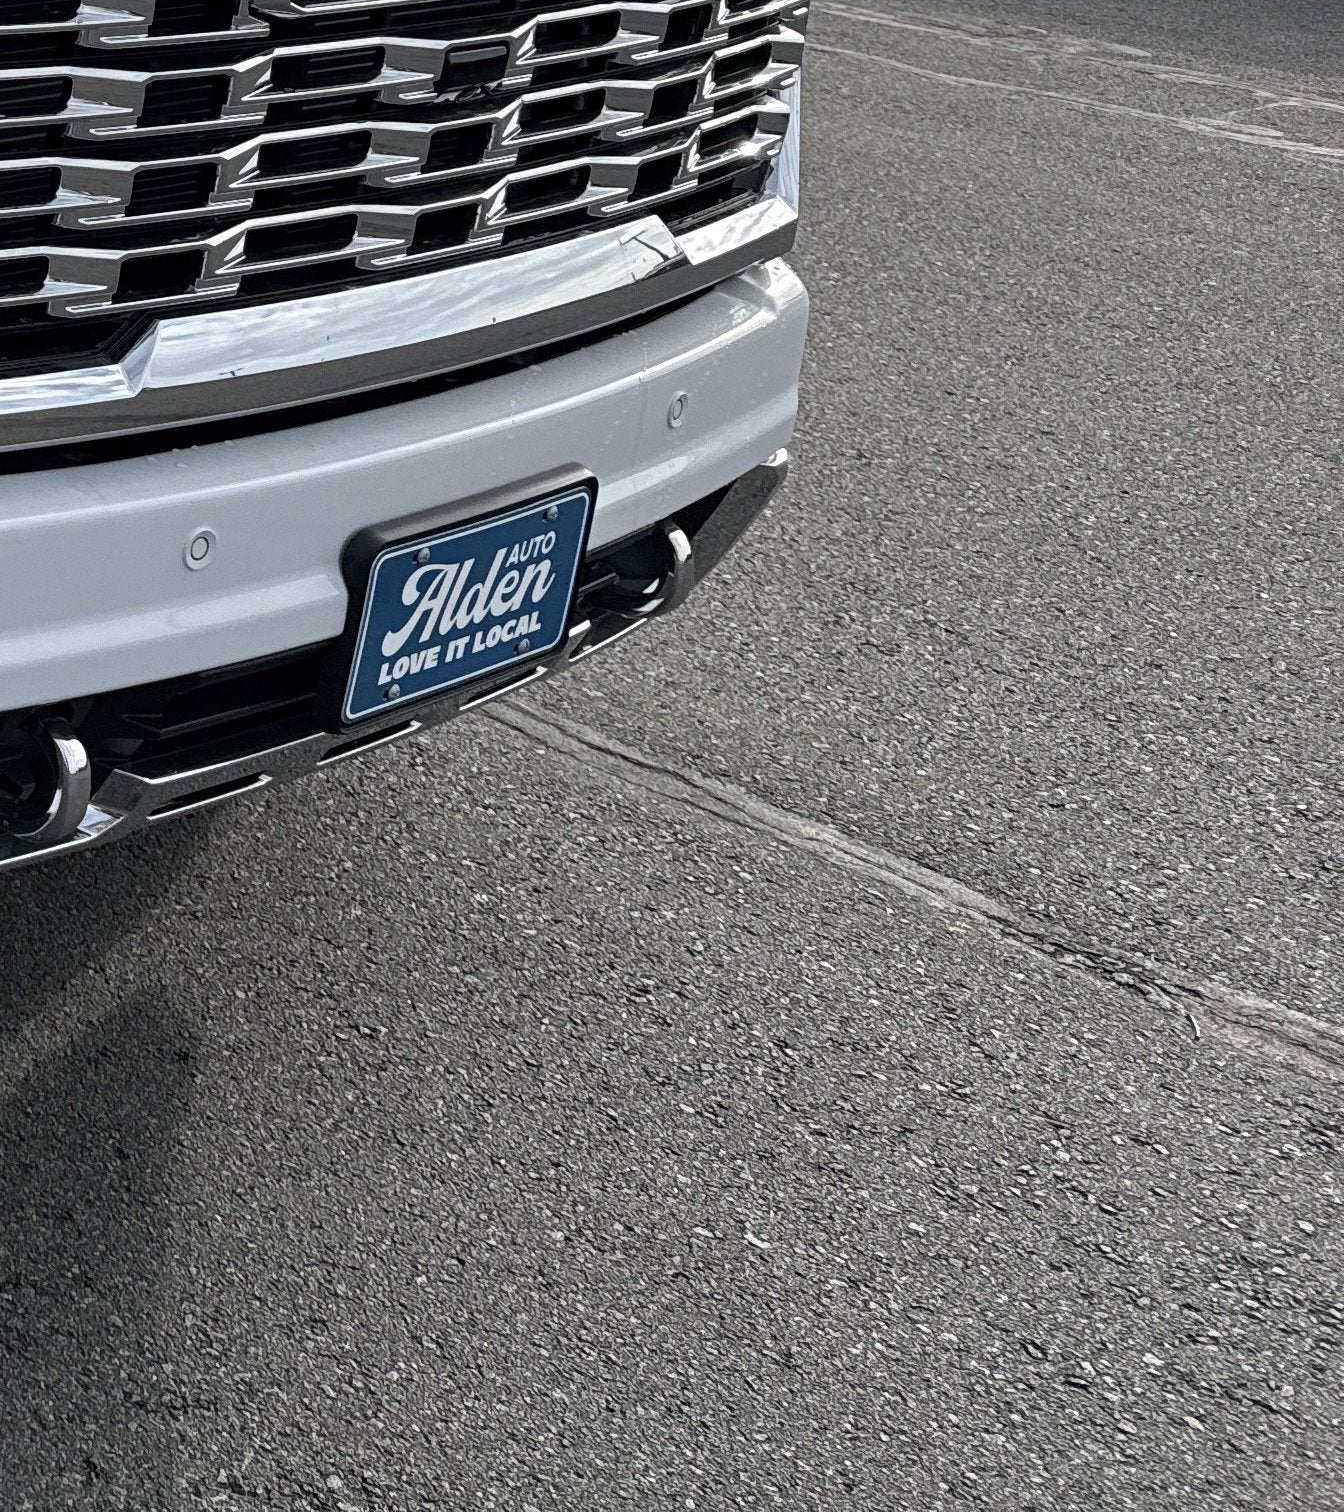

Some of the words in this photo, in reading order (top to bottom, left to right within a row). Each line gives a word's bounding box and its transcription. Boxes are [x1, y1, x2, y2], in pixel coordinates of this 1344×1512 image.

[505, 530, 556, 568] AUTO
[381, 547, 556, 657] Alden
[378, 645, 441, 686] LOVE
[445, 635, 471, 663] IT
[472, 610, 542, 654] LOCAL
